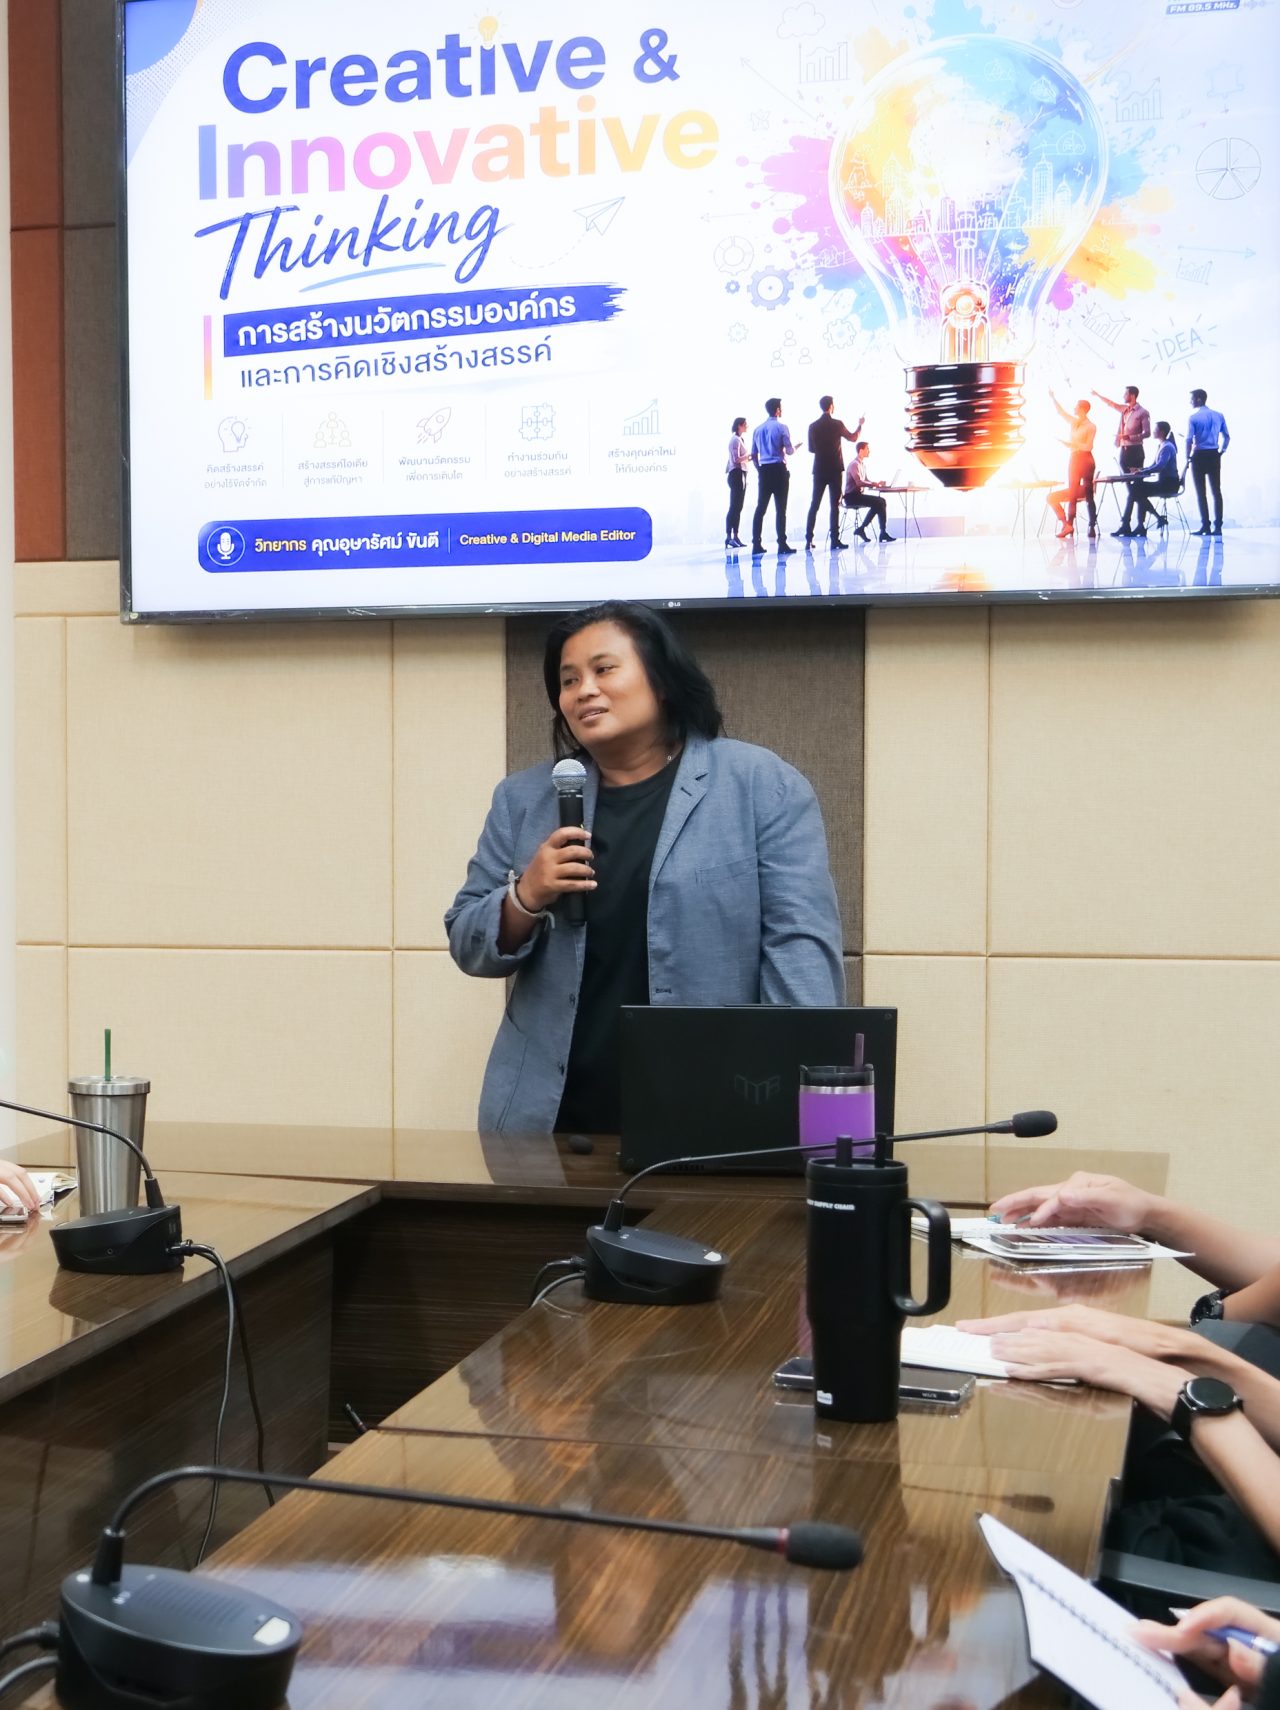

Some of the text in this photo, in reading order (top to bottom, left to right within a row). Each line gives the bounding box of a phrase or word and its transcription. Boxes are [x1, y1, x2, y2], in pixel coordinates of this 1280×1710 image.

[222, 27, 681, 114] Creative &
[198, 94, 720, 200] Innovative
[194, 194, 514, 300] Thinking
[236, 291, 577, 347] การสร้างนวัตกรรมองค์กร
[1155, 327, 1204, 361] IDEA
[240, 335, 552, 388] และการคิดเชิงสร้างสรรค์
[254, 537, 307, 552] วิทยากร
[311, 531, 402, 557] คุณอุษารัศม์
[459, 529, 636, 546] Creative & Digital Media Editor
